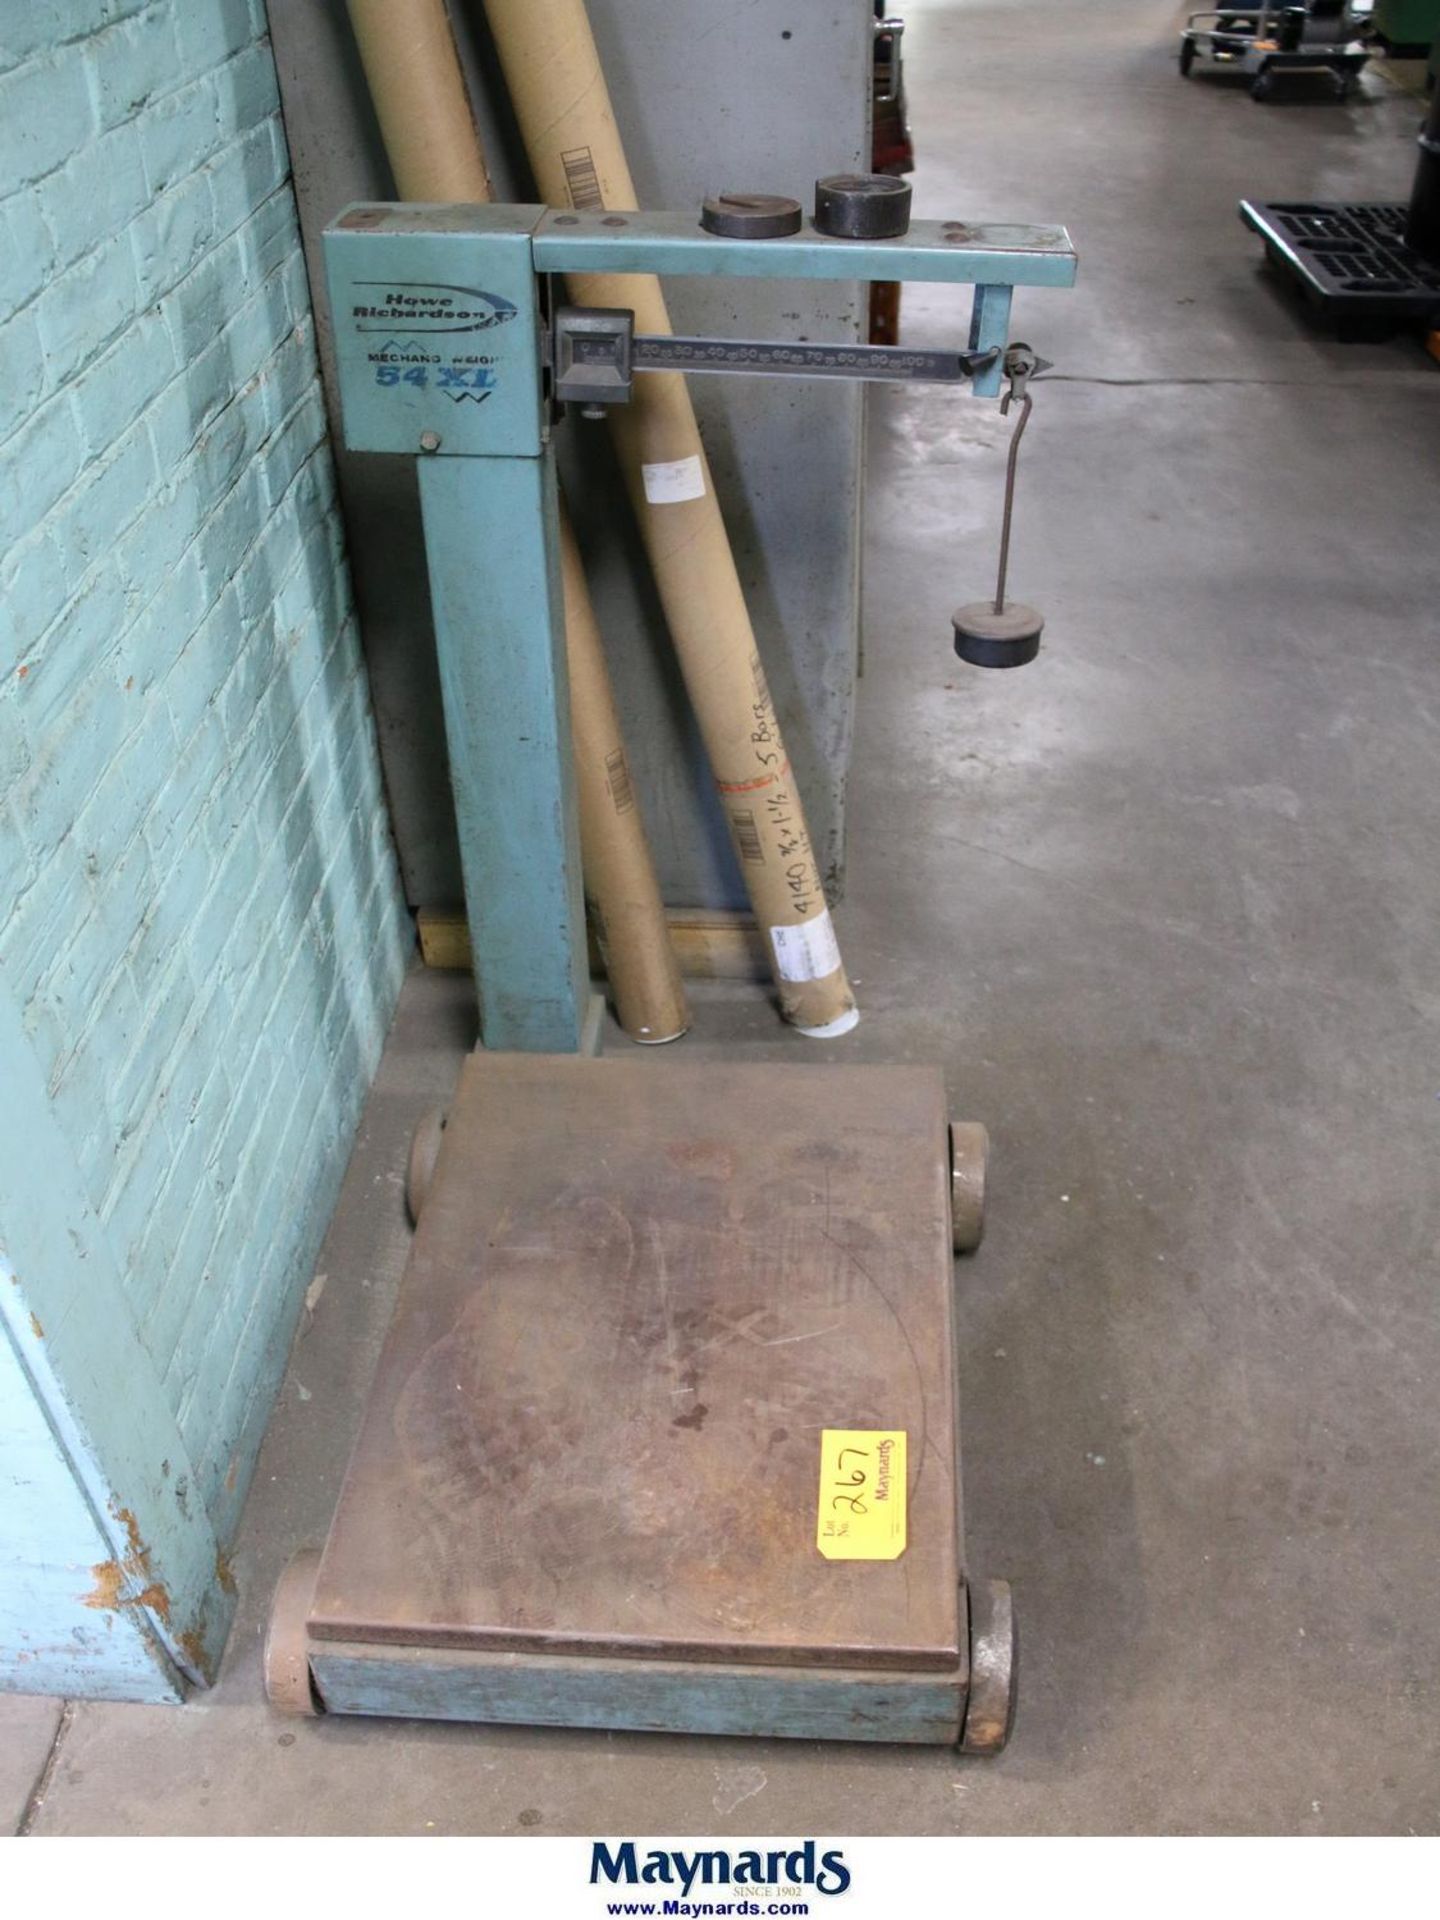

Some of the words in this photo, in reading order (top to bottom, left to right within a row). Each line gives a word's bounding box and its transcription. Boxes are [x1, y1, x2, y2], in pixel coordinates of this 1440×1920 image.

[385, 294, 453, 306] Howe
[353, 306, 486, 319] Richardson
[640, 344, 659, 355] 20
[707, 347, 726, 358] 40
[739, 348, 757, 359] 50
[772, 349, 790, 360] 60
[806, 351, 823, 362] 70
[871, 354, 888, 365] 90
[902, 356, 925, 367] 100
[375, 366, 428, 387] 54
[435, 367, 498, 388] XL
[750, 704, 771, 742] Bars
[756, 750, 778, 766] 5
[785, 862, 816, 914] 4140
[832, 1448, 869, 1514] 267
[874, 1439, 895, 1501] Maynards
[823, 1520, 836, 1536] Lot
